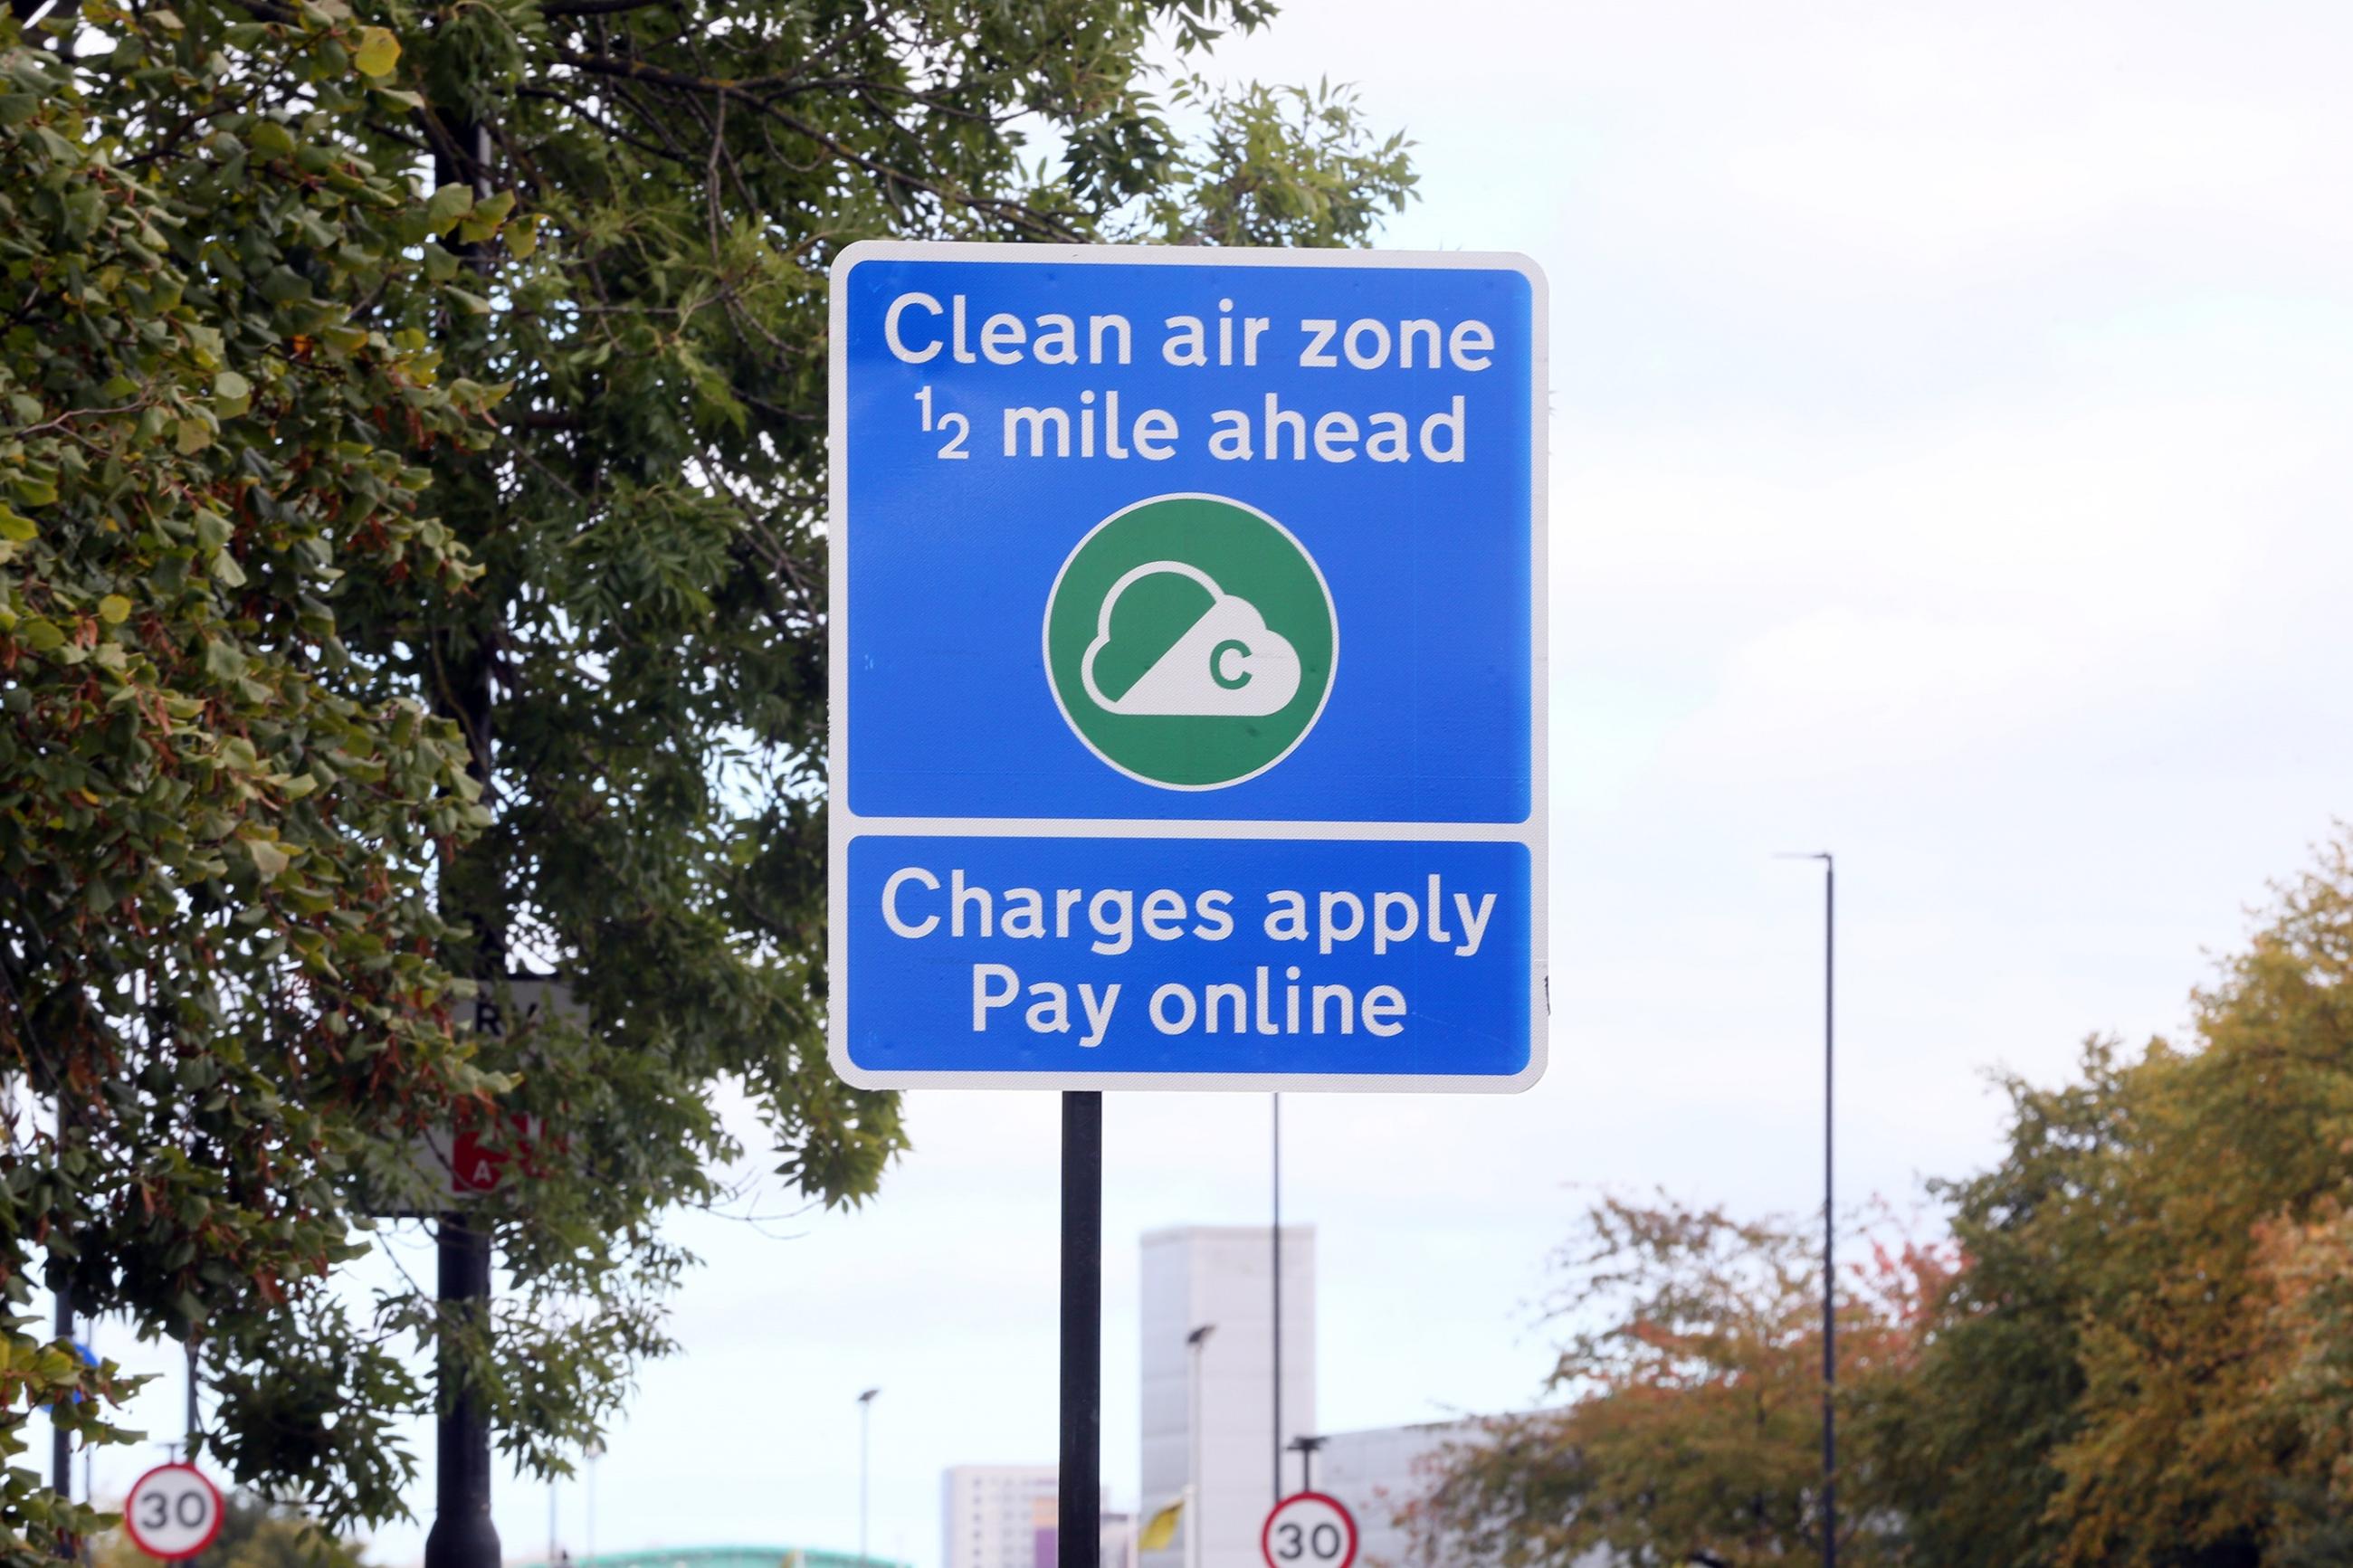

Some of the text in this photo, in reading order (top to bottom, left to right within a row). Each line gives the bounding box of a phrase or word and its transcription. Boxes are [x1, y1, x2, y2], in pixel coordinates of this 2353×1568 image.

[884, 291, 1495, 372] Clean air zone
[1003, 389, 1179, 461] mile
[1208, 392, 1465, 463] ahead
[1209, 639, 1253, 690] C
[881, 867, 1497, 957] Charges apply
[973, 963, 1407, 1048] Pay online
[140, 1490, 207, 1530] 30
[1276, 1522, 1342, 1560] 30
